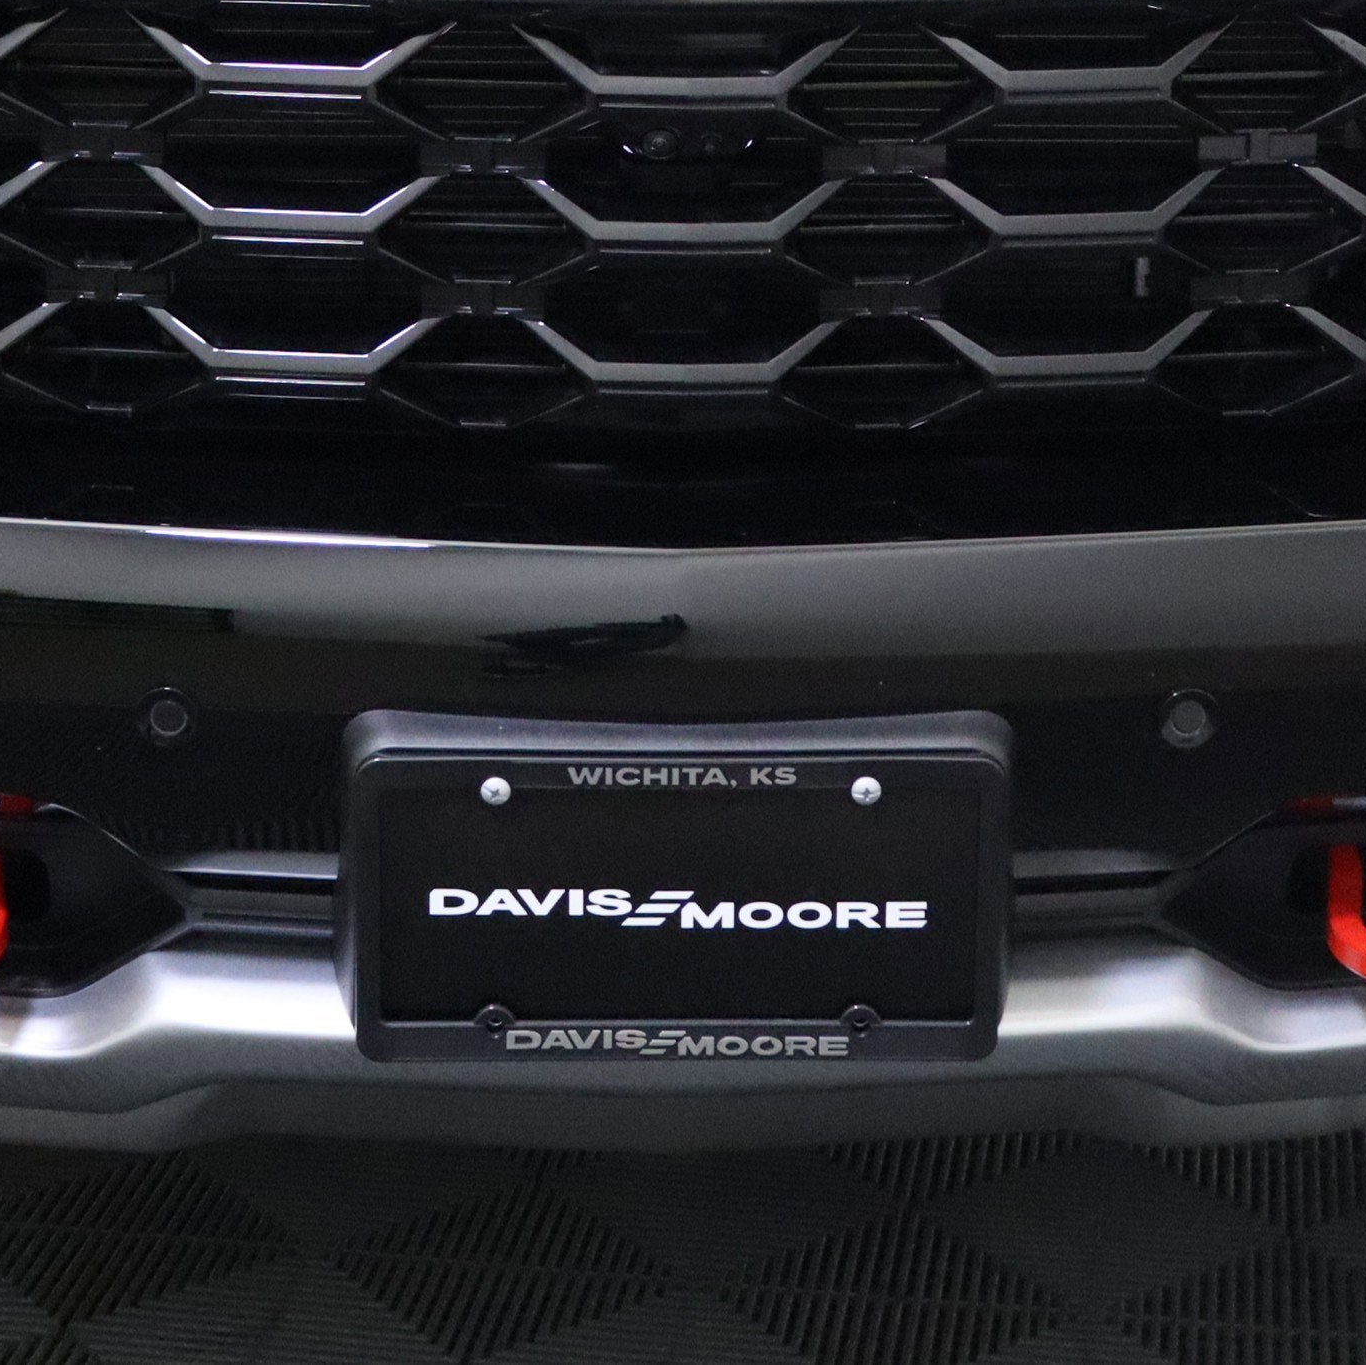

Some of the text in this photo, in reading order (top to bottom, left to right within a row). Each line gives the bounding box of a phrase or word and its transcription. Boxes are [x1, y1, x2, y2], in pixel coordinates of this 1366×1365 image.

[567, 766, 798, 788] WICHITA, KS
[428, 887, 929, 930] DAVIS MOORE
[505, 1028, 850, 1057] DAVIS MOORE
